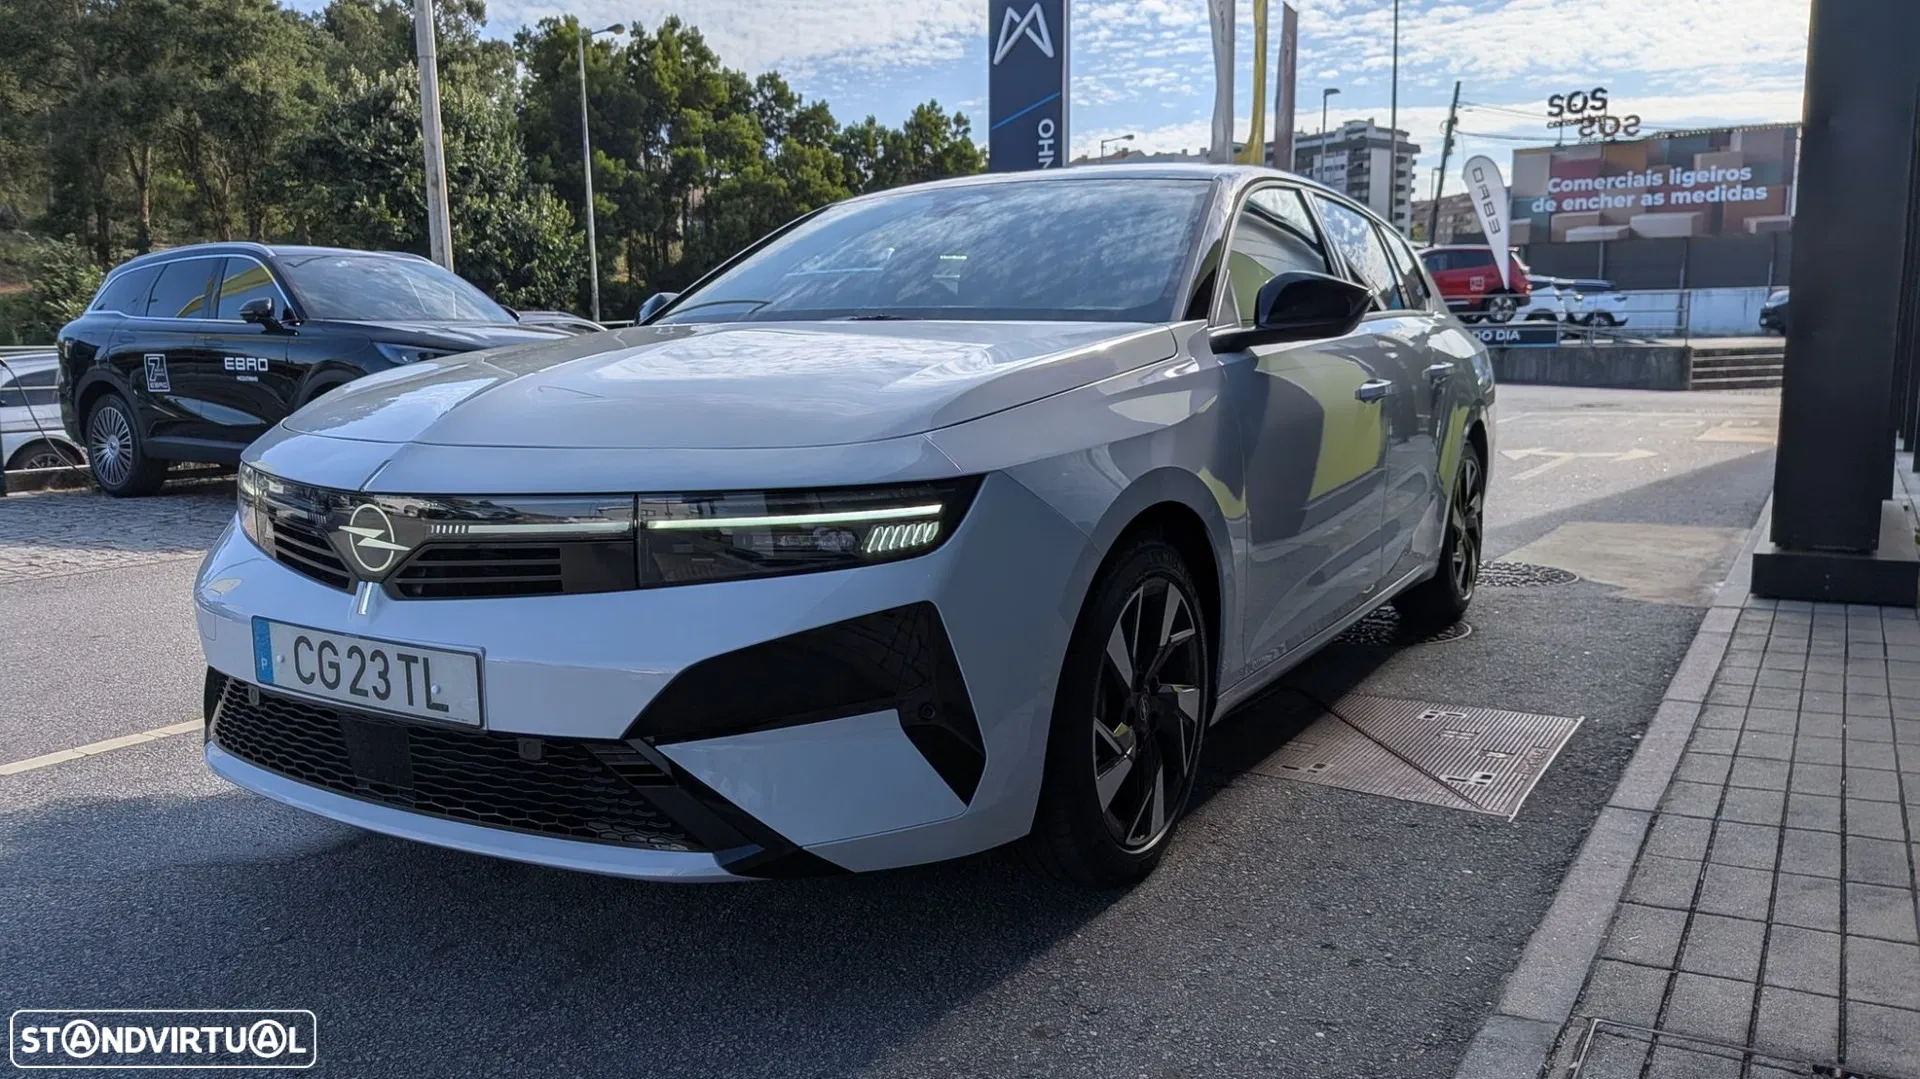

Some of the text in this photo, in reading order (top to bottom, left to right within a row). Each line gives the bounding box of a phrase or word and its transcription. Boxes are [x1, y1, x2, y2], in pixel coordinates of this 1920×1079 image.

[1547, 87, 1608, 117] SOS
[1548, 166, 1753, 194] Comerciais ligeiros
[1531, 184, 1768, 213] de encher as medidas
[1496, 329, 1521, 341] DIA
[224, 357, 269, 371] EBRO
[261, 657, 268, 671] P
